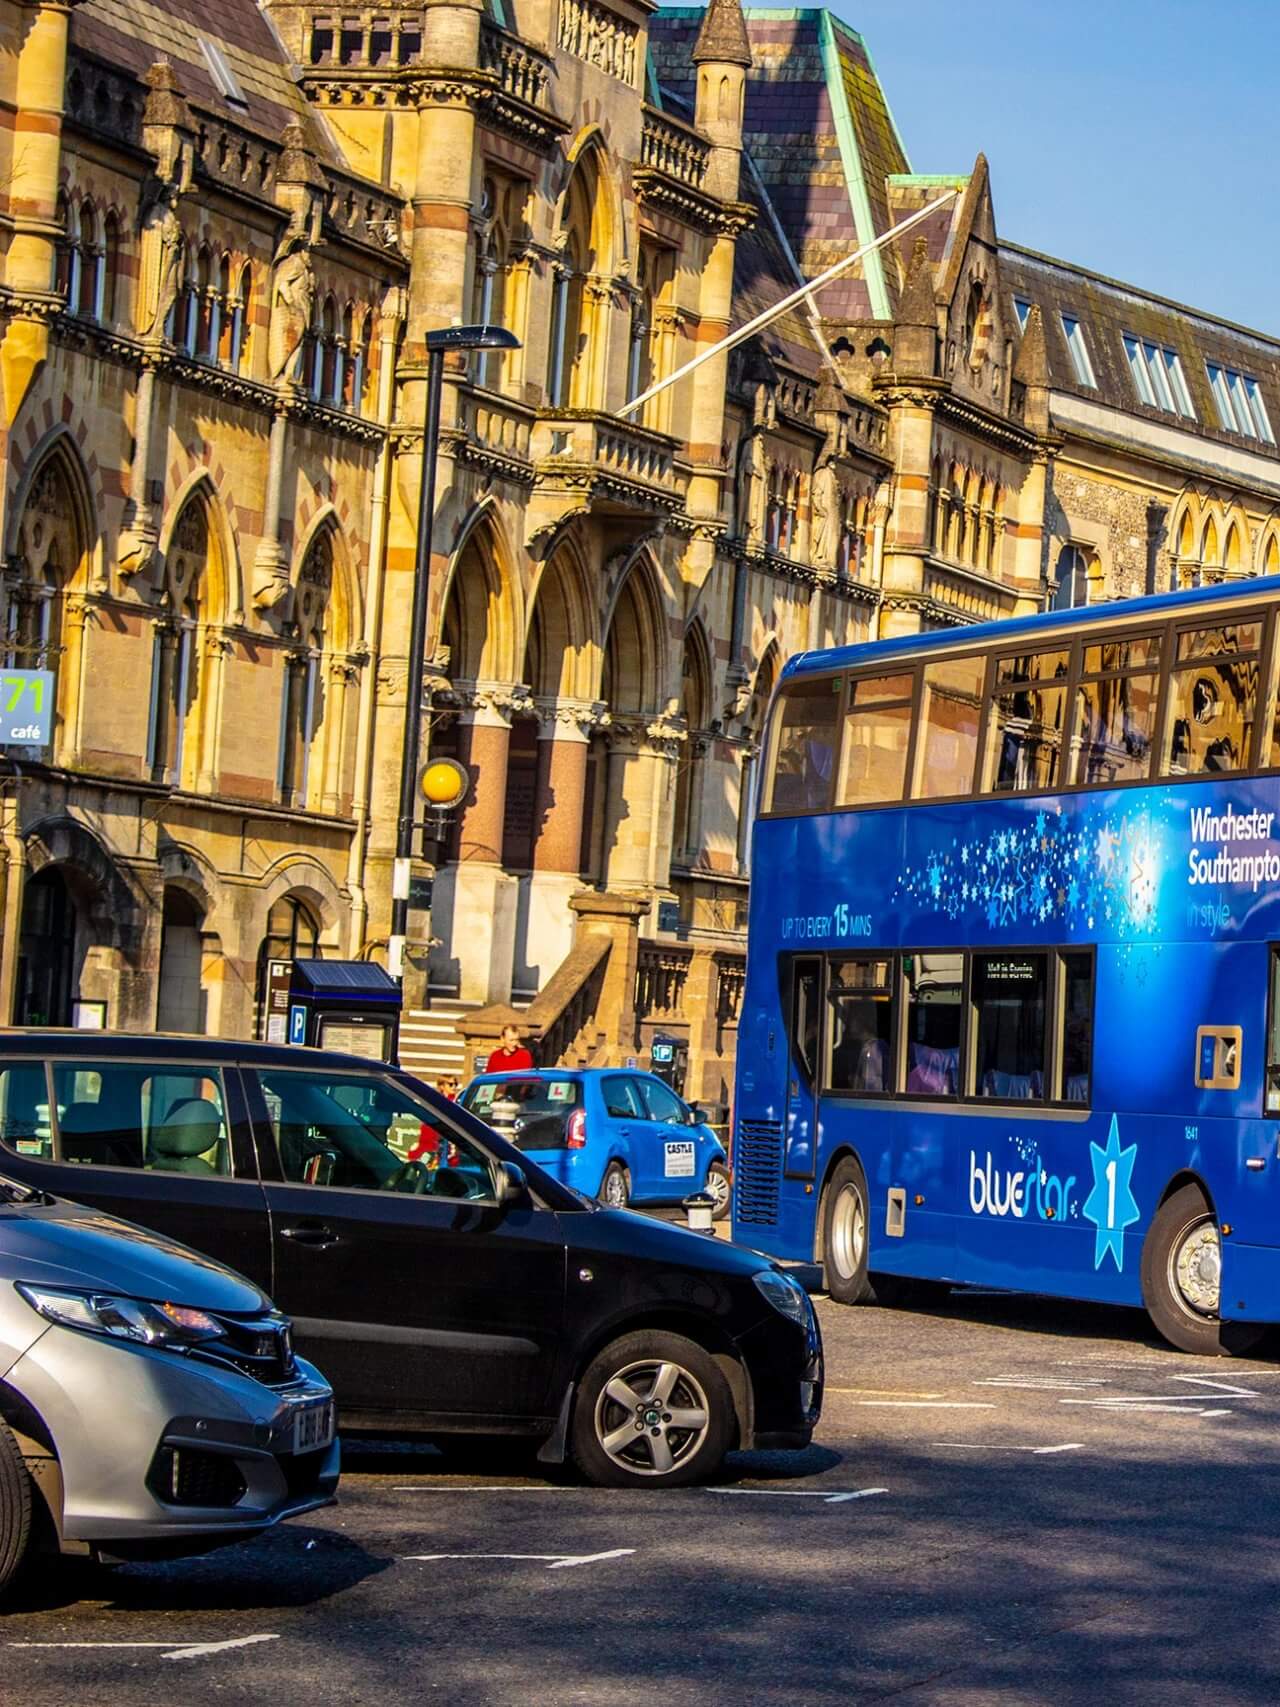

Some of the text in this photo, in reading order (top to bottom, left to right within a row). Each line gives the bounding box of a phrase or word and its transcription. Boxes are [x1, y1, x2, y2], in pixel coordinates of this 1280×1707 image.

[4, 677, 43, 714] 71
[11, 725, 41, 739] café
[1190, 802, 1275, 843] Winchester
[782, 903, 873, 938] UP TO EVERY 15 MINS
[1200, 891, 1230, 937] style
[294, 1012, 303, 1038] P
[667, 1144, 692, 1154] CASTLE
[1185, 1125, 1198, 1140] 1641
[970, 1150, 1076, 1221] bluestar
[1106, 1161, 1116, 1229] 1
